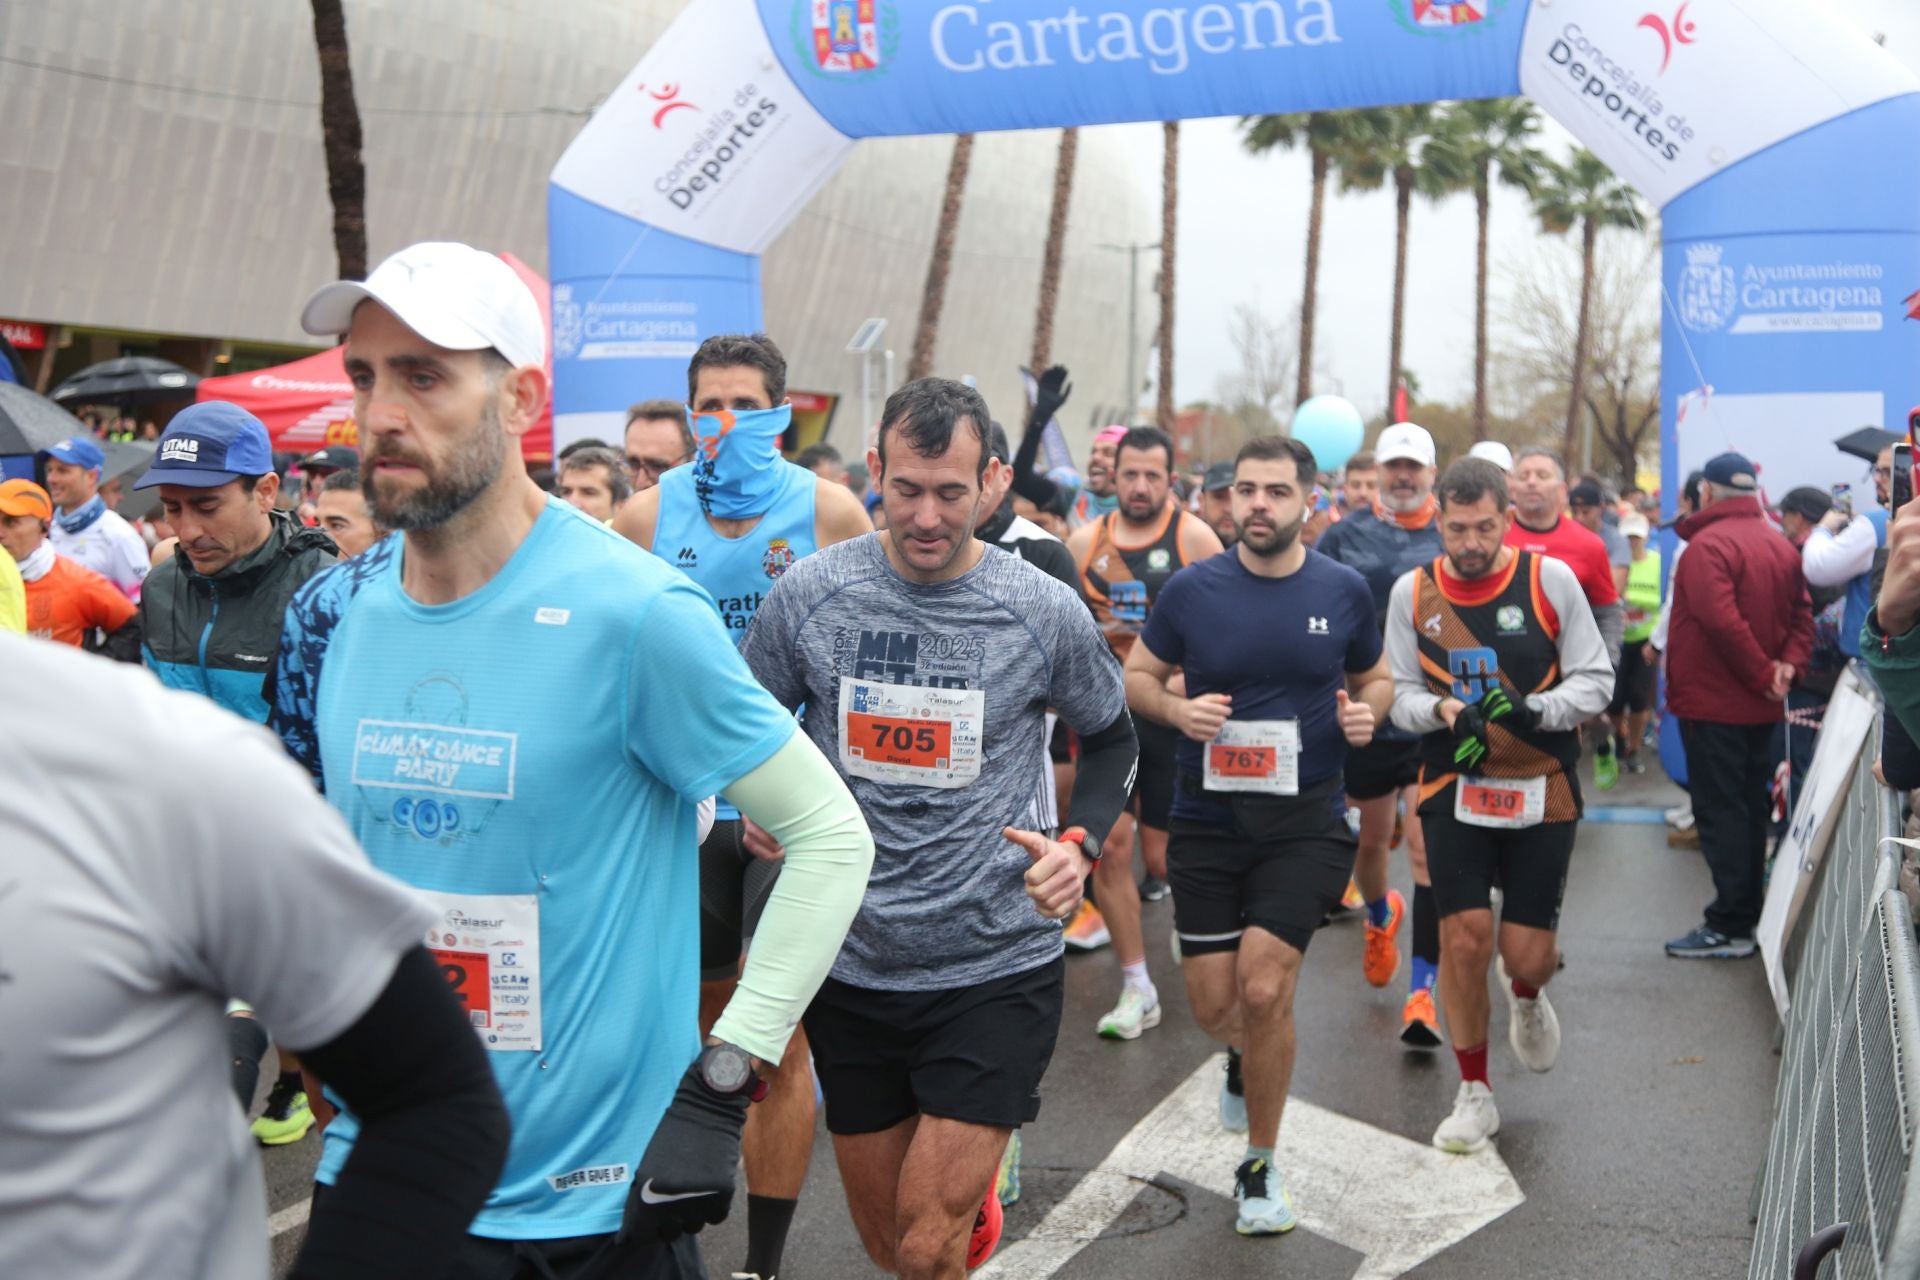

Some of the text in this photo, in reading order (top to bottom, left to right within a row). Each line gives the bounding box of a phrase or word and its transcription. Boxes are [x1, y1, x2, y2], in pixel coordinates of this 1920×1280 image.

[929, 0, 1343, 75] Cartagena
[1548, 38, 1681, 162] Deportes
[1665, 113, 1695, 142] de
[668, 96, 778, 210] Deportes
[1741, 261, 1884, 286] Ayuntamiento
[585, 300, 698, 316] Ayuntamiento
[1741, 283, 1884, 312] Cartagena
[584, 319, 698, 342] Cartagena
[162, 438, 199, 453] UTMB
[857, 630, 920, 664] MM
[917, 632, 986, 662] 2025
[919, 658, 931, 670] 32
[871, 723, 936, 753] 705
[433, 740, 504, 766] DANCE
[1224, 750, 1266, 769] 767
[394, 756, 462, 787] PARTY
[1479, 791, 1517, 810] 130
[439, 963, 469, 1002] 2
[491, 975, 529, 985] UCAM
[555, 1166, 625, 1190] NEVER GIVE UP
